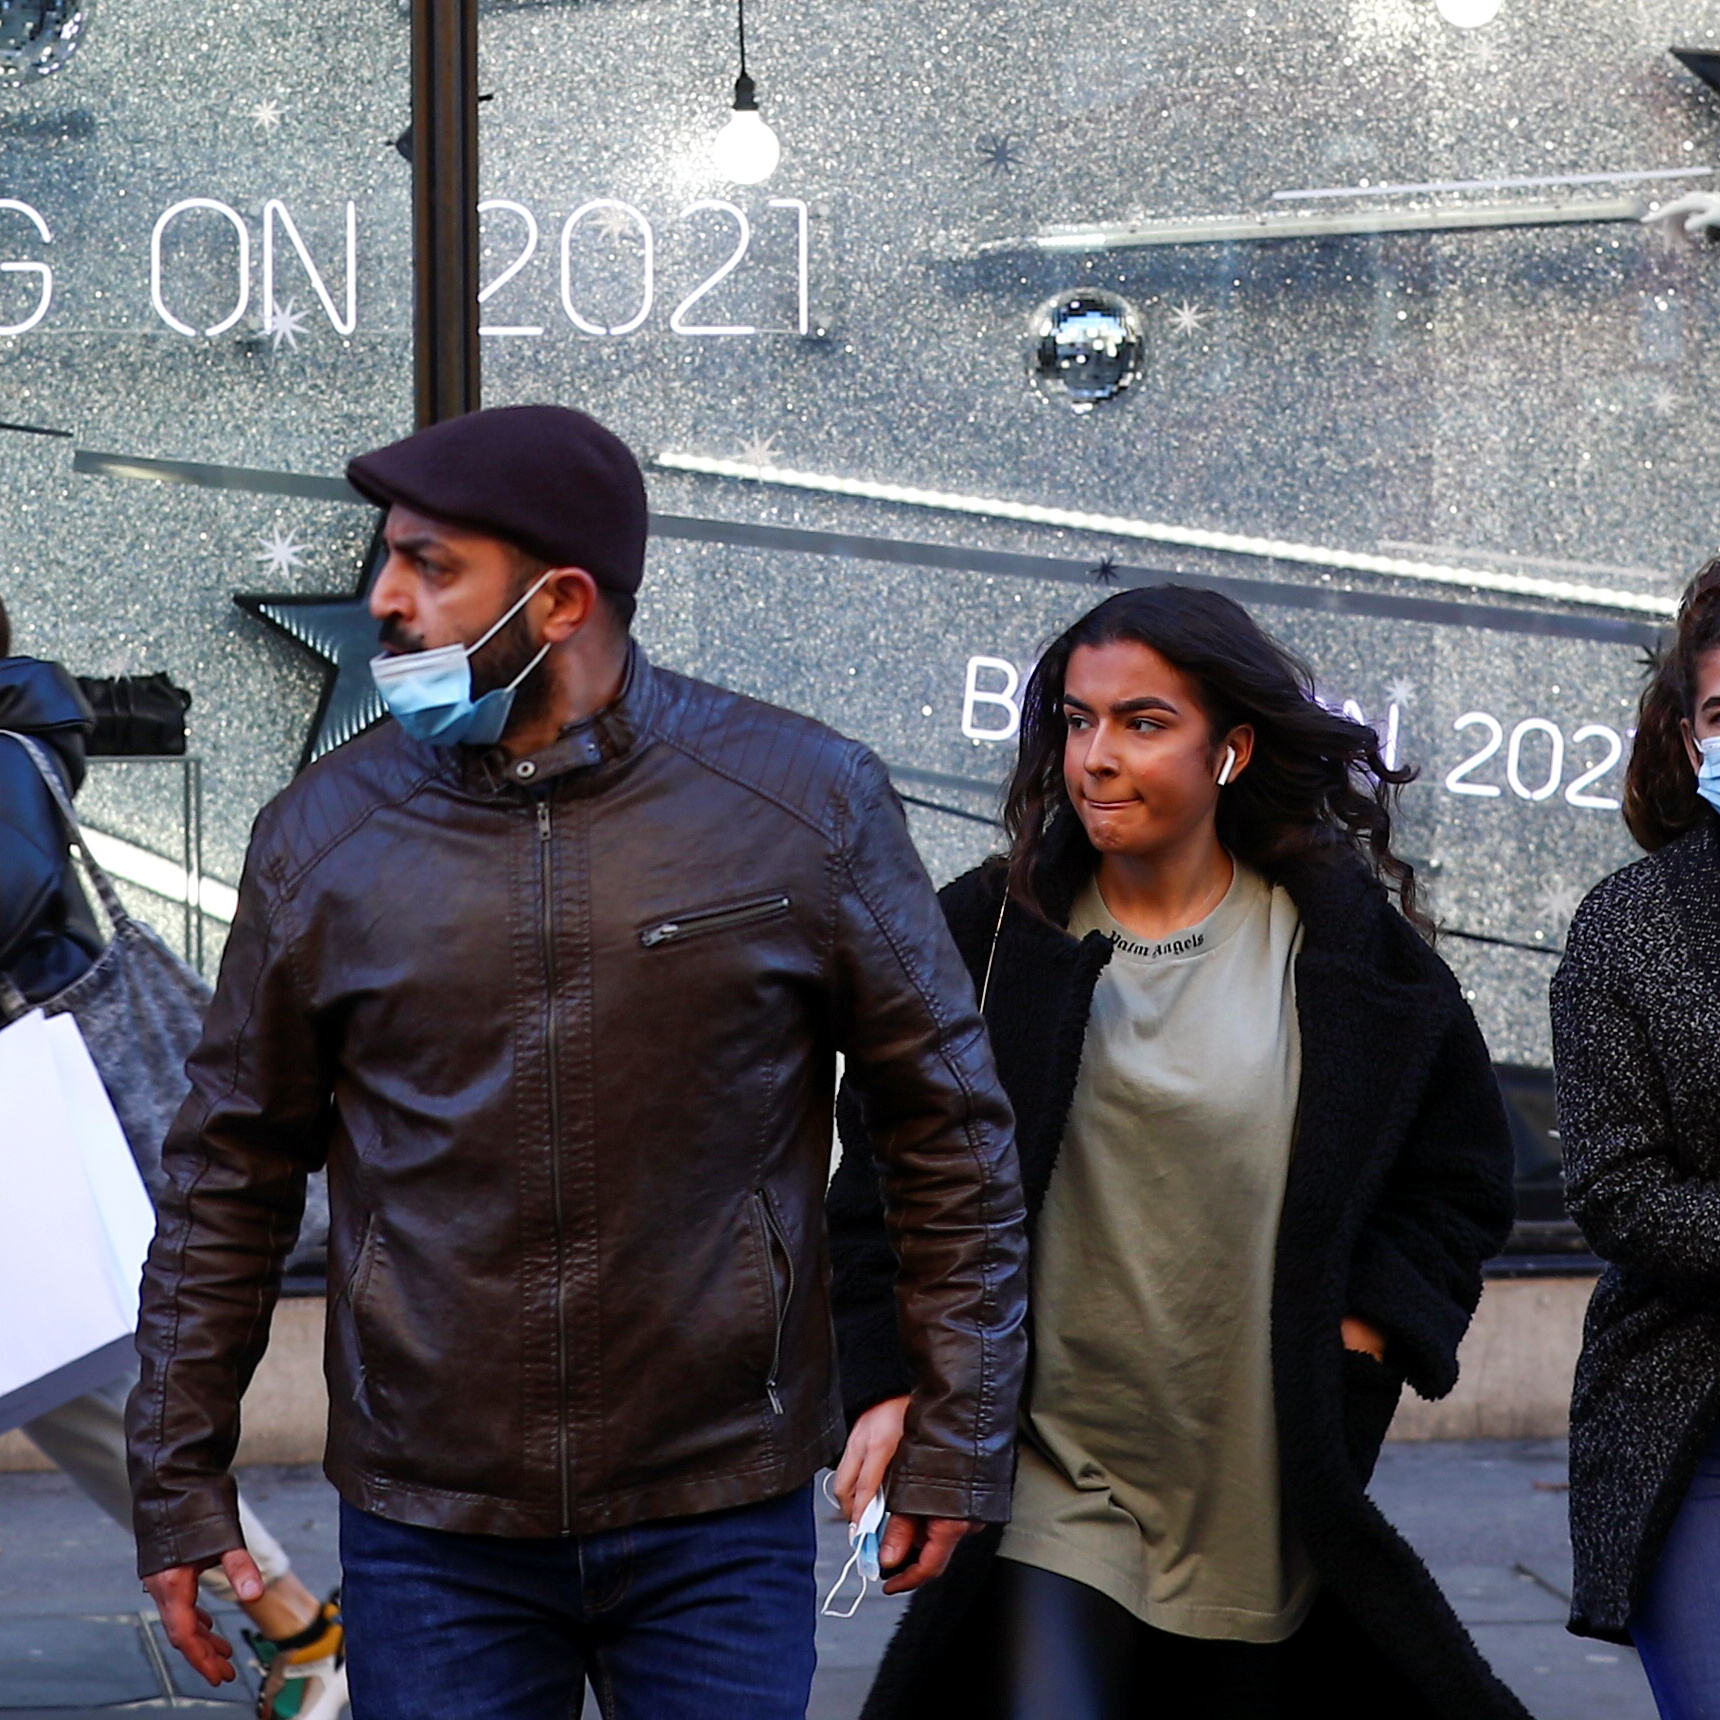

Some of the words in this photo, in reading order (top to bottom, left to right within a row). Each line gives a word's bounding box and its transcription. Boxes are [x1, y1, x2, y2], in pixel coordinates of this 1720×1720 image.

[150, 198, 357, 336] ON
[477, 198, 812, 336] 2021
[1445, 711, 1638, 810] 202
[1109, 929, 1150, 957] Palm
[1152, 933, 1205, 959] Angels
